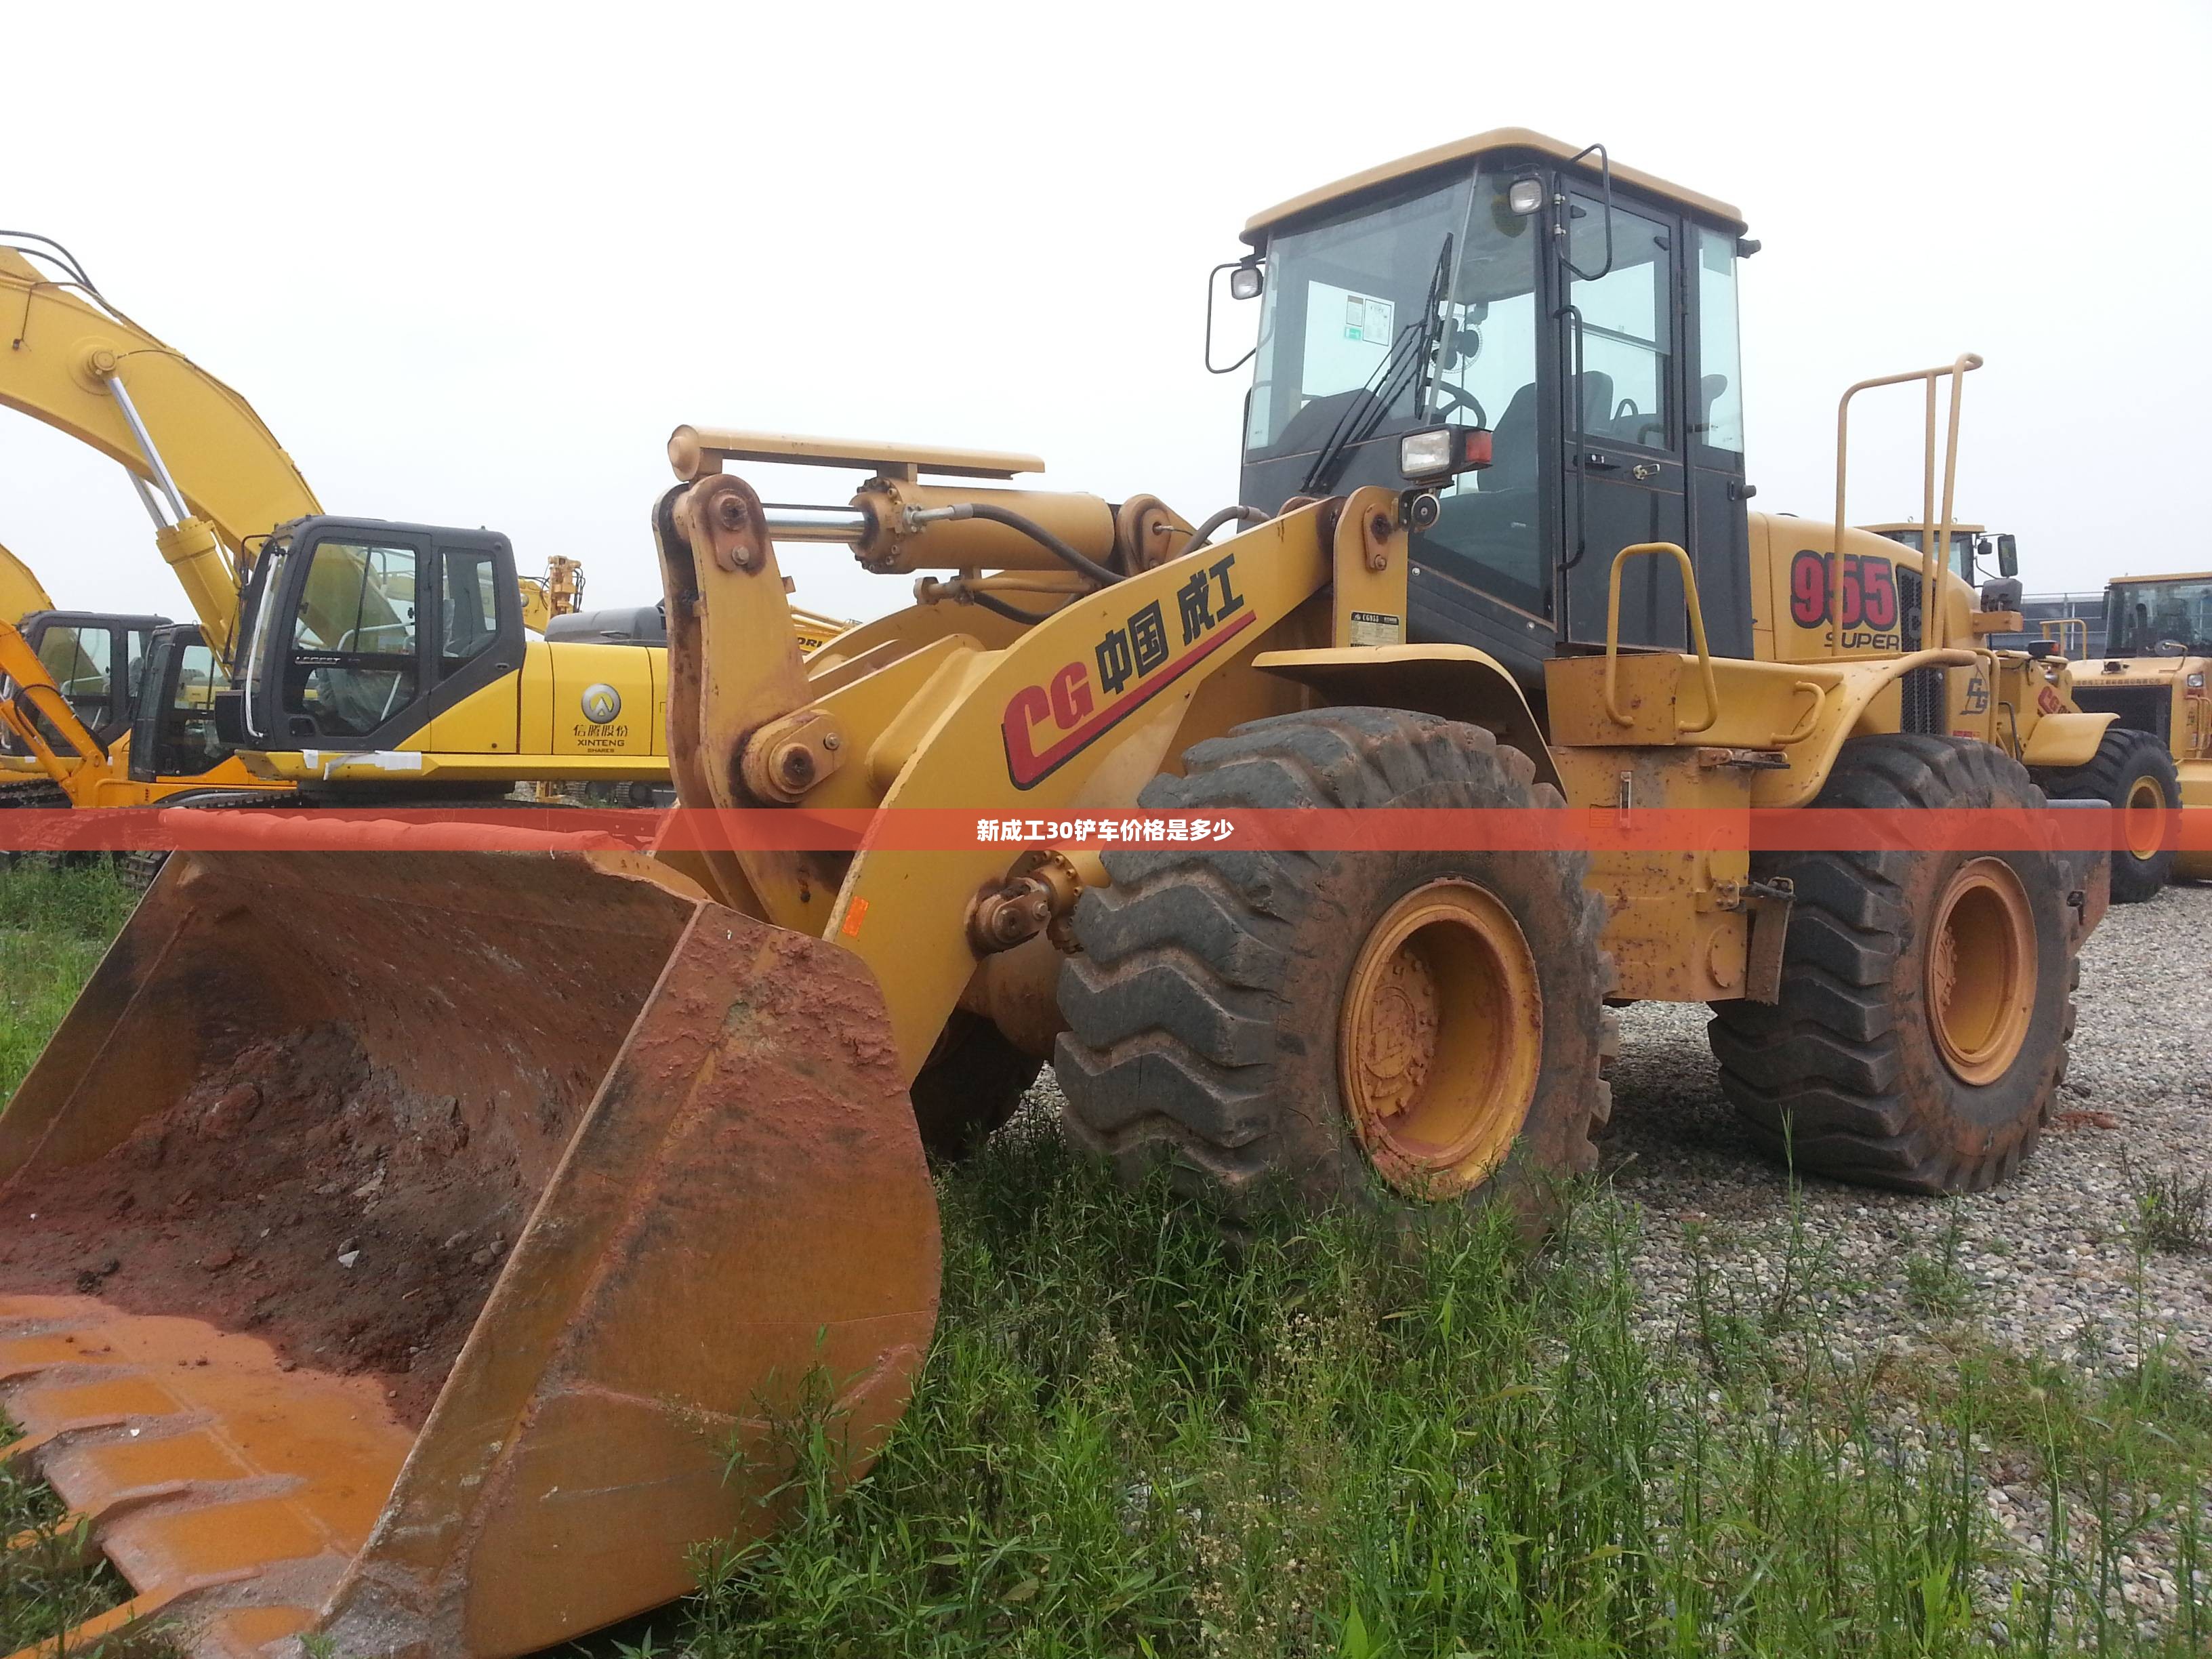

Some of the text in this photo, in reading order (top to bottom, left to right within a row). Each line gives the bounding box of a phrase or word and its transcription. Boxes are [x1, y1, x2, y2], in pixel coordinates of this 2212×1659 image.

[1790, 550, 1898, 632] 955
[1824, 631, 1900, 651] SUPER
[1002, 661, 1095, 790] CG
[1095, 599, 1169, 695] 中国
